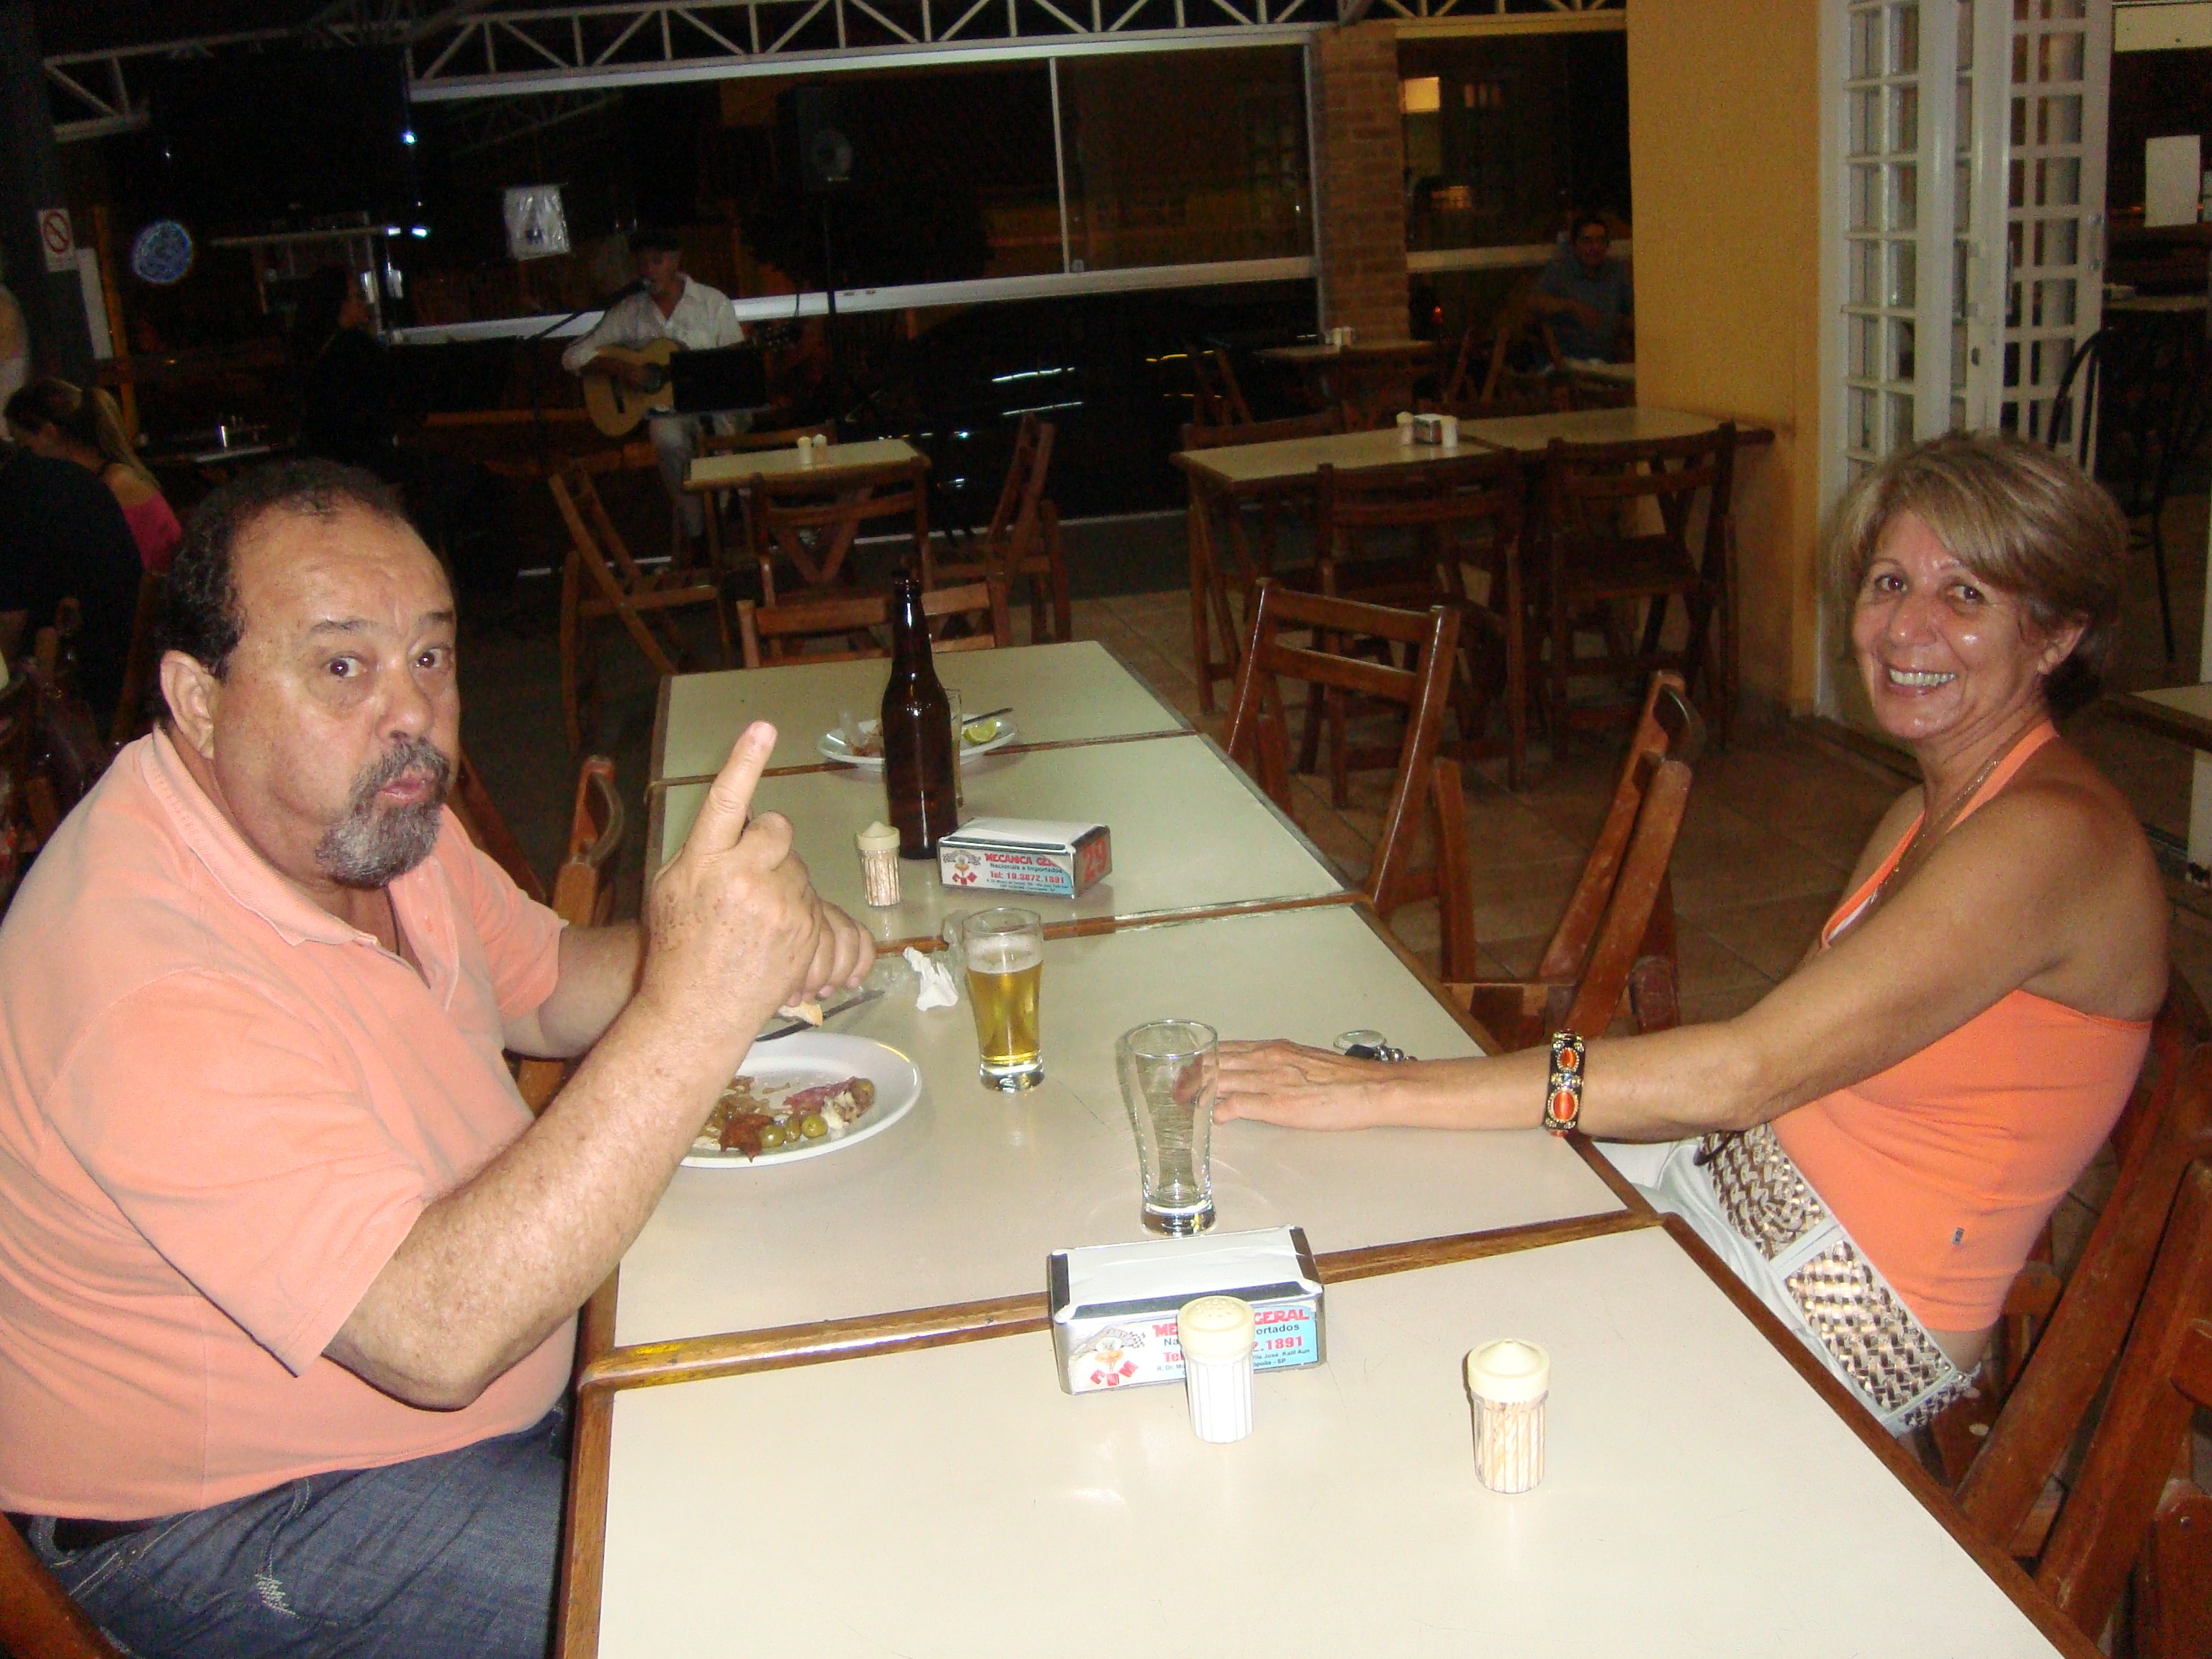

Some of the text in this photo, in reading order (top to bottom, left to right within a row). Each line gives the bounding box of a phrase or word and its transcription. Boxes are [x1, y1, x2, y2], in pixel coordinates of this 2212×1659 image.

[1254, 1309, 1310, 1325] GERAL
[1256, 1323, 1300, 1334] ortados
[1252, 1336, 1302, 1352] 2.1891
